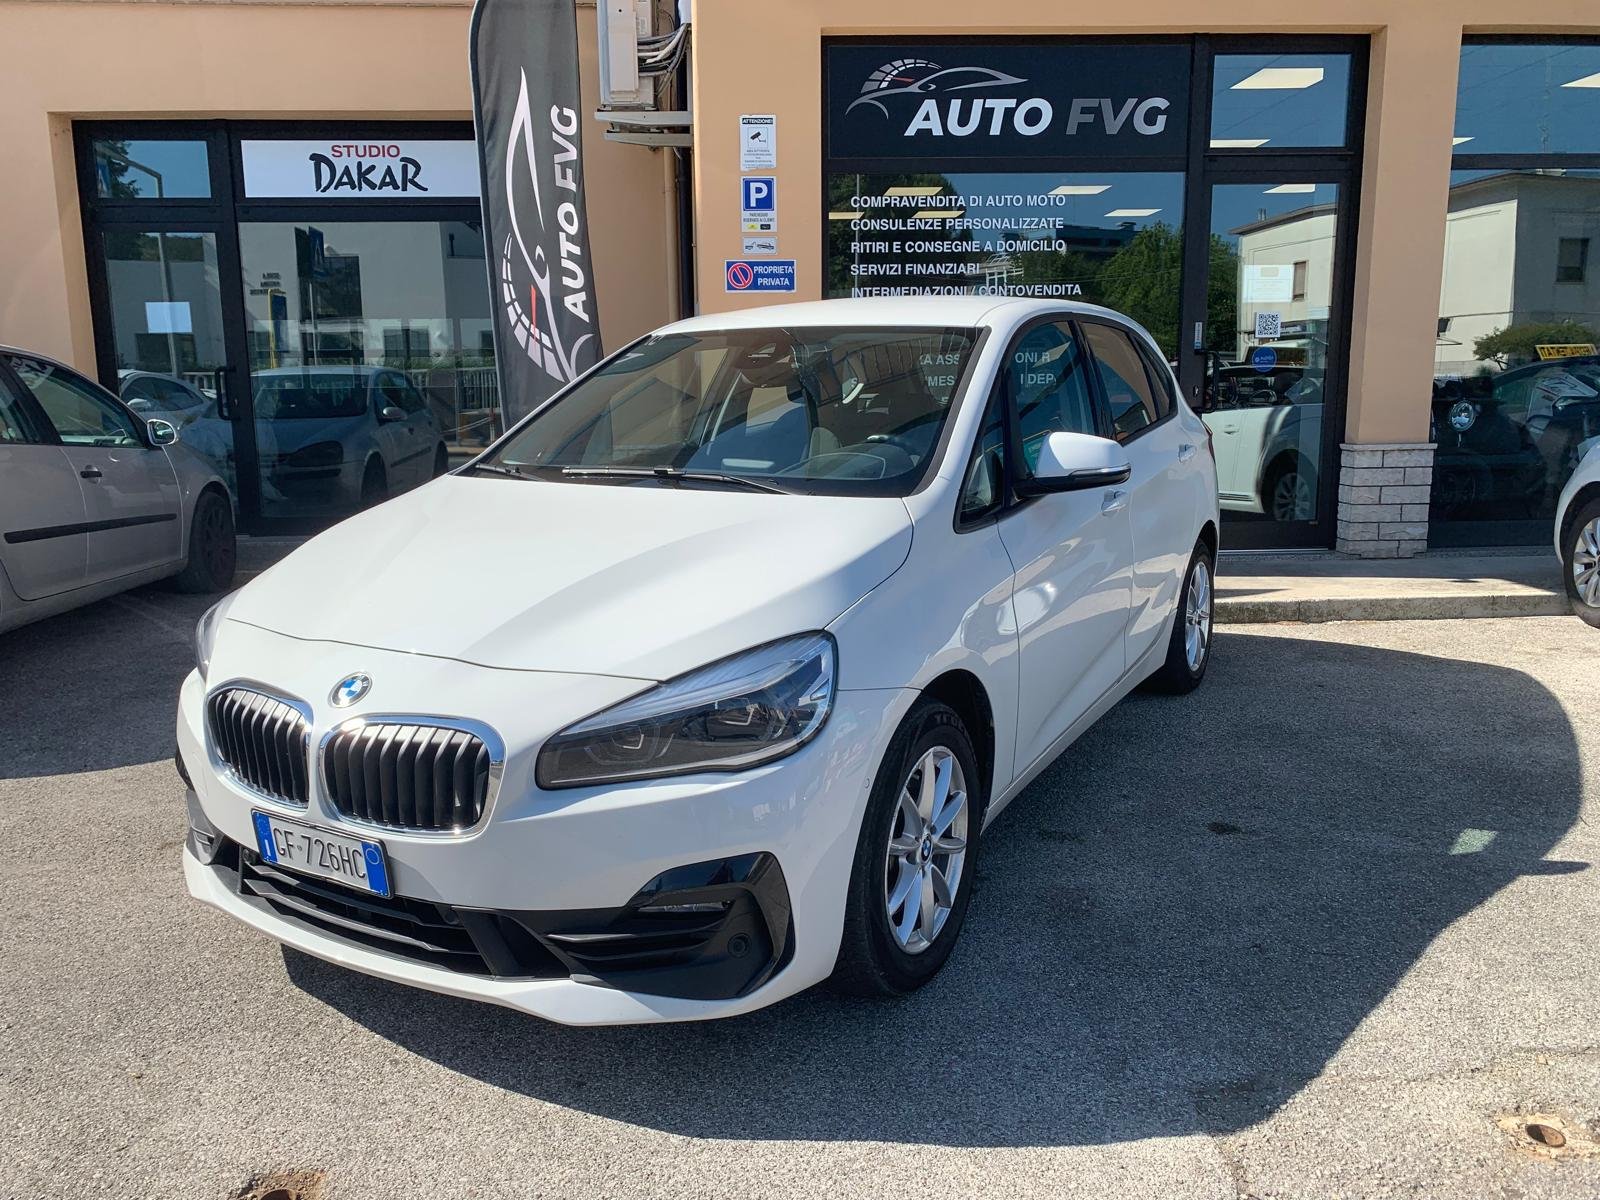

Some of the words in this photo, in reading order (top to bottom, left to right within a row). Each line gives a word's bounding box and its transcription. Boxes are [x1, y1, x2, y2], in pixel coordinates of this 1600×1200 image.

[904, 97, 1053, 137] AUTO
[1065, 97, 1171, 136] FVG
[331, 144, 401, 158] STUDIO
[550, 105, 578, 192] FVG
[309, 153, 428, 193] DAKAR
[750, 182, 768, 207] P
[850, 195, 965, 208] COMPRAVENDITA
[969, 195, 983, 207] DI
[986, 195, 1023, 207] AUTO
[1026, 194, 1066, 207] MOTO
[850, 218, 942, 231] CONSULENZE
[946, 217, 1064, 230] PERSONALIZZATE
[850, 242, 889, 254] RITIRI
[893, 242, 902, 253] E
[905, 241, 980, 253] CONSEGNE
[983, 241, 993, 252] A
[996, 240, 1066, 252] DOMICILIO
[557, 202, 590, 323] AUTO
[850, 264, 902, 276] SERVIZI
[905, 263, 980, 275] FINANZIARI
[757, 277, 790, 286] PRIVATA
[851, 286, 967, 298] INTERMEDIAZIONI
[978, 284, 1082, 297] CONTOVENDITA
[301, 834, 366, 879] 726HC
